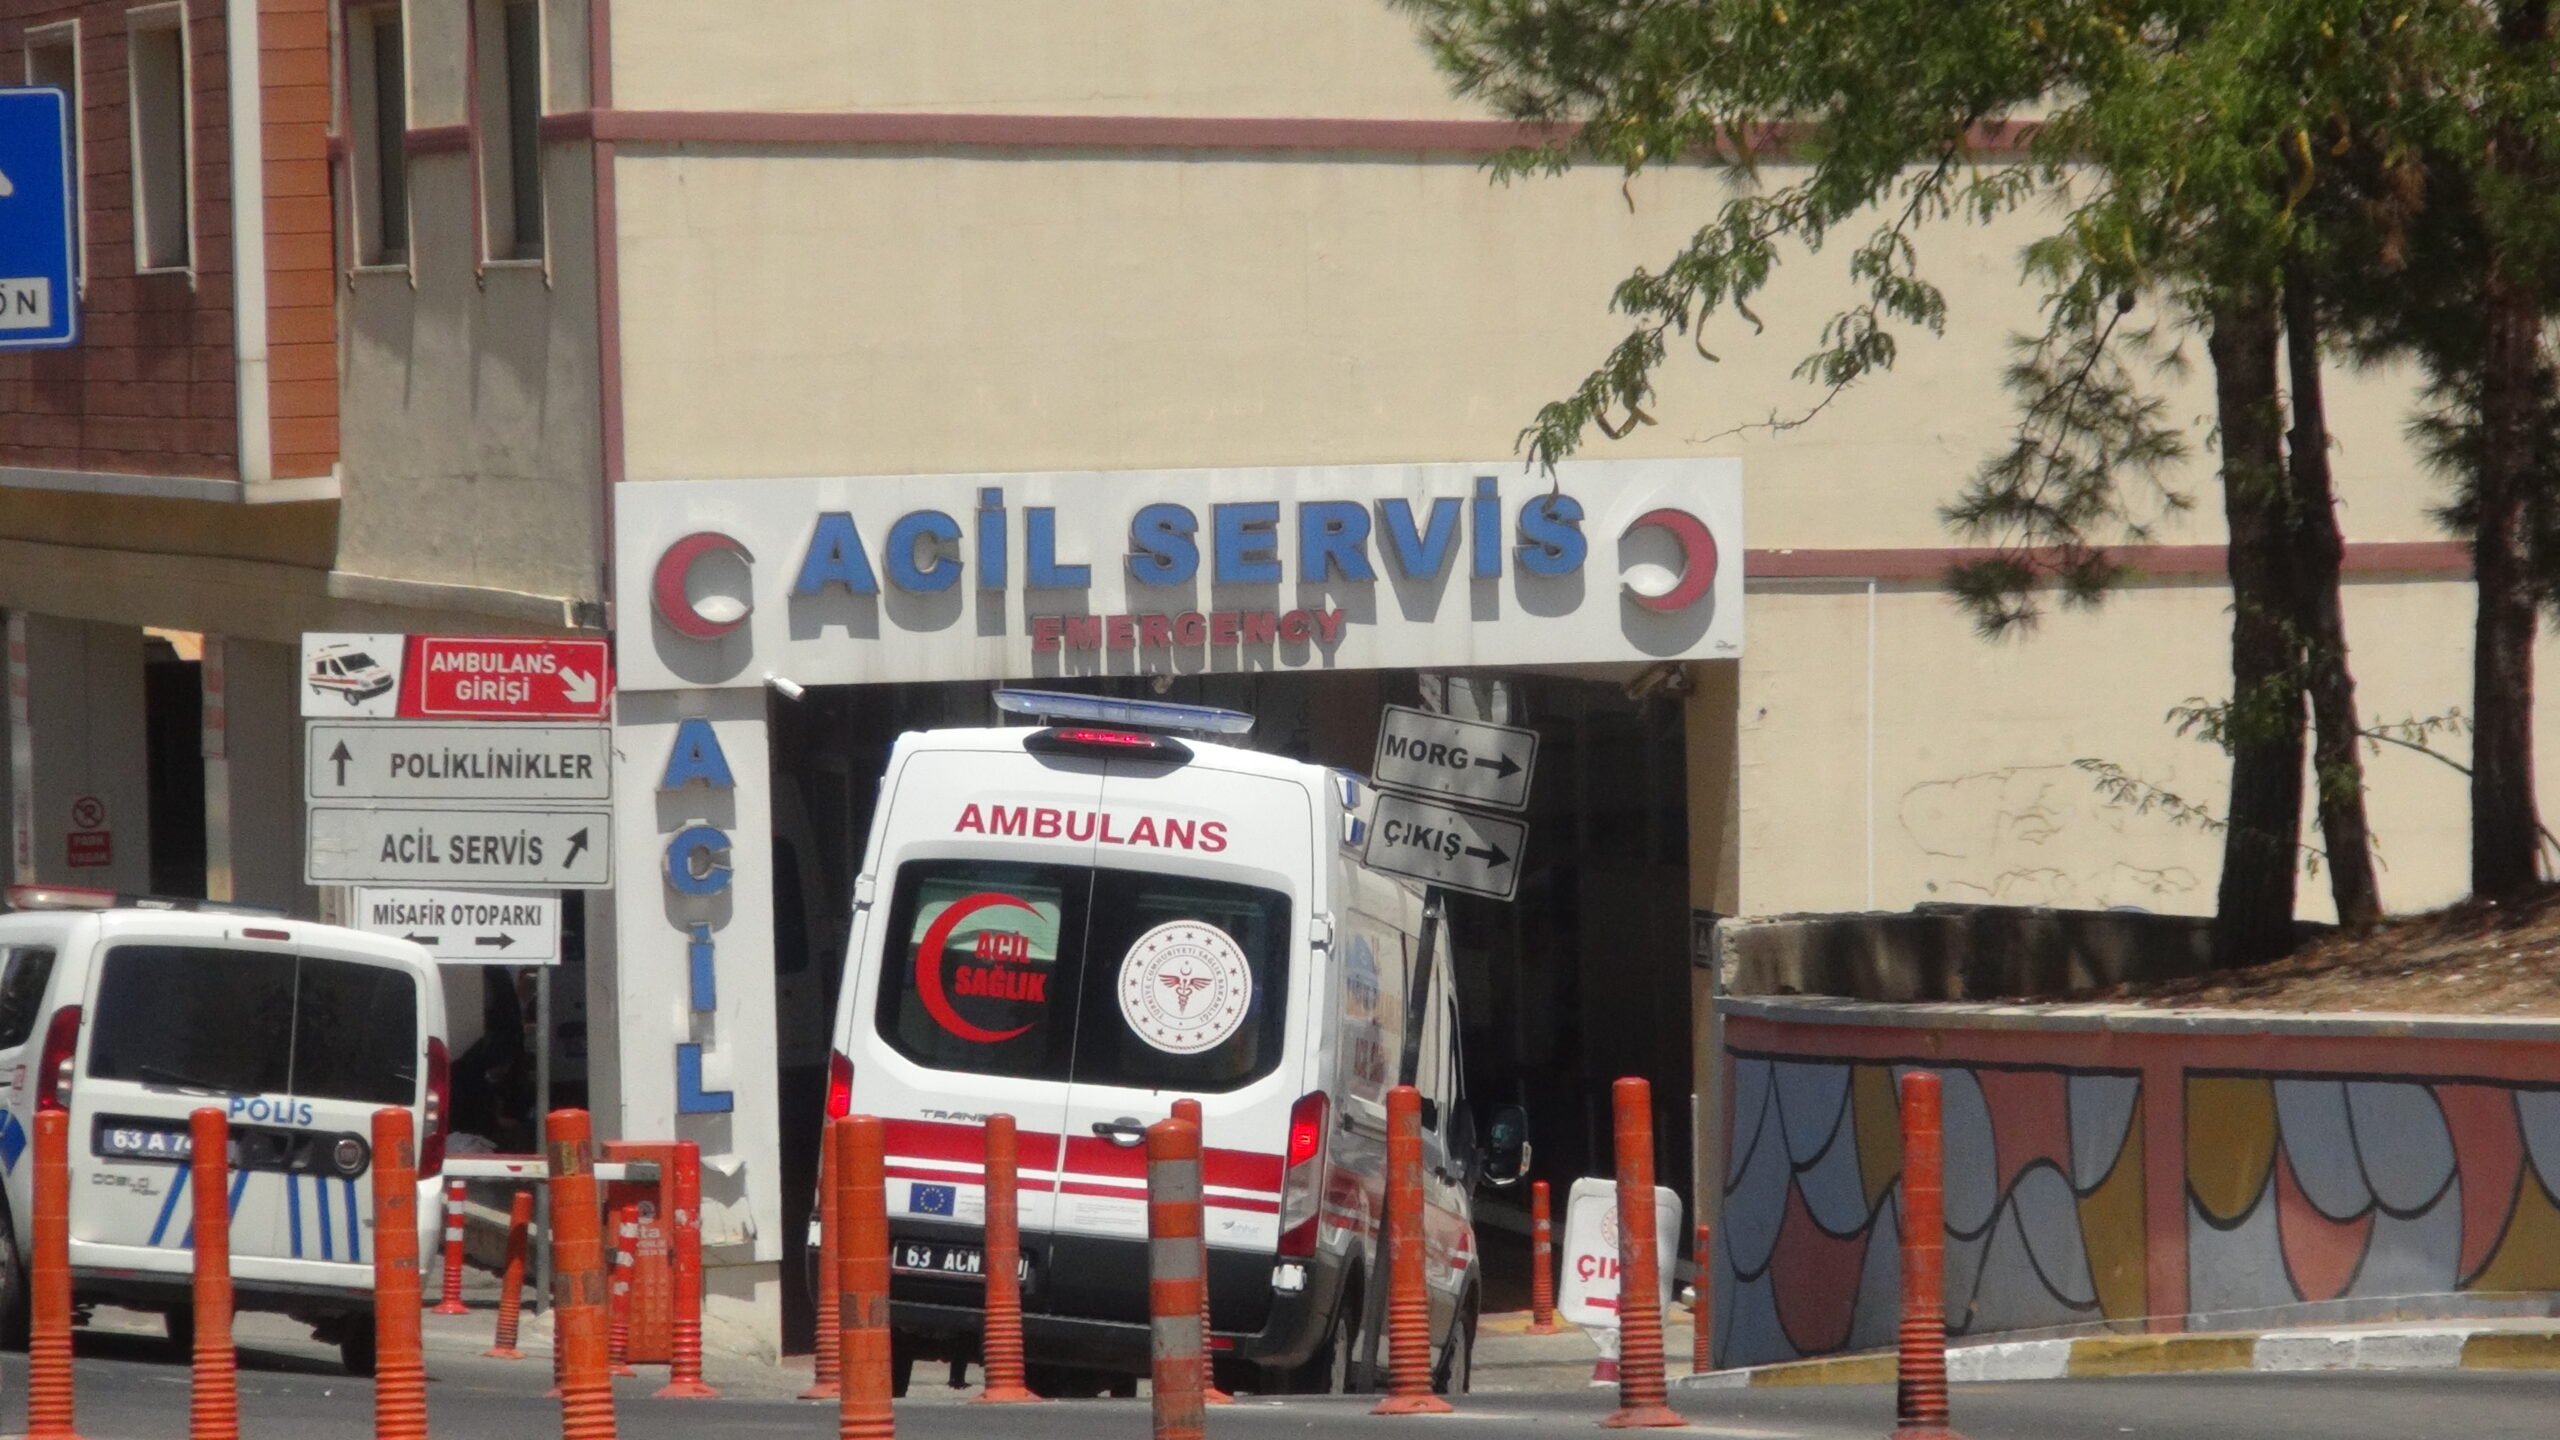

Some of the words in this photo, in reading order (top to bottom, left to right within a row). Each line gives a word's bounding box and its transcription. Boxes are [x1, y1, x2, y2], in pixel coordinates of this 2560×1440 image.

[788, 486, 1092, 596] ACİL
[1123, 476, 1588, 588] SERVİS
[1031, 607, 1346, 652] EMERGENCY
[430, 651, 558, 674] AMBULANS
[455, 676, 531, 704] GİRİŞİ
[390, 747, 593, 780] POLİKLİNİKLER
[1384, 734, 1469, 770] MORG
[954, 803, 1229, 853] AMBULANS
[1383, 819, 1462, 861] ÇIKIŞ
[380, 827, 440, 864] ACİL
[449, 829, 544, 866] SERVİS
[373, 897, 446, 926] MİSAFİR
[451, 904, 542, 927] OTOPARKI
[661, 717, 736, 1114] ACİL
[975, 929, 1031, 964] ACİL
[954, 963, 1048, 1003] SAĞLIK
[228, 1096, 313, 1127] POLİS
[113, 1129, 142, 1149] 63
[148, 1132, 166, 1151] A
[906, 1245, 932, 1268] 63
[943, 1250, 981, 1273] ACN
